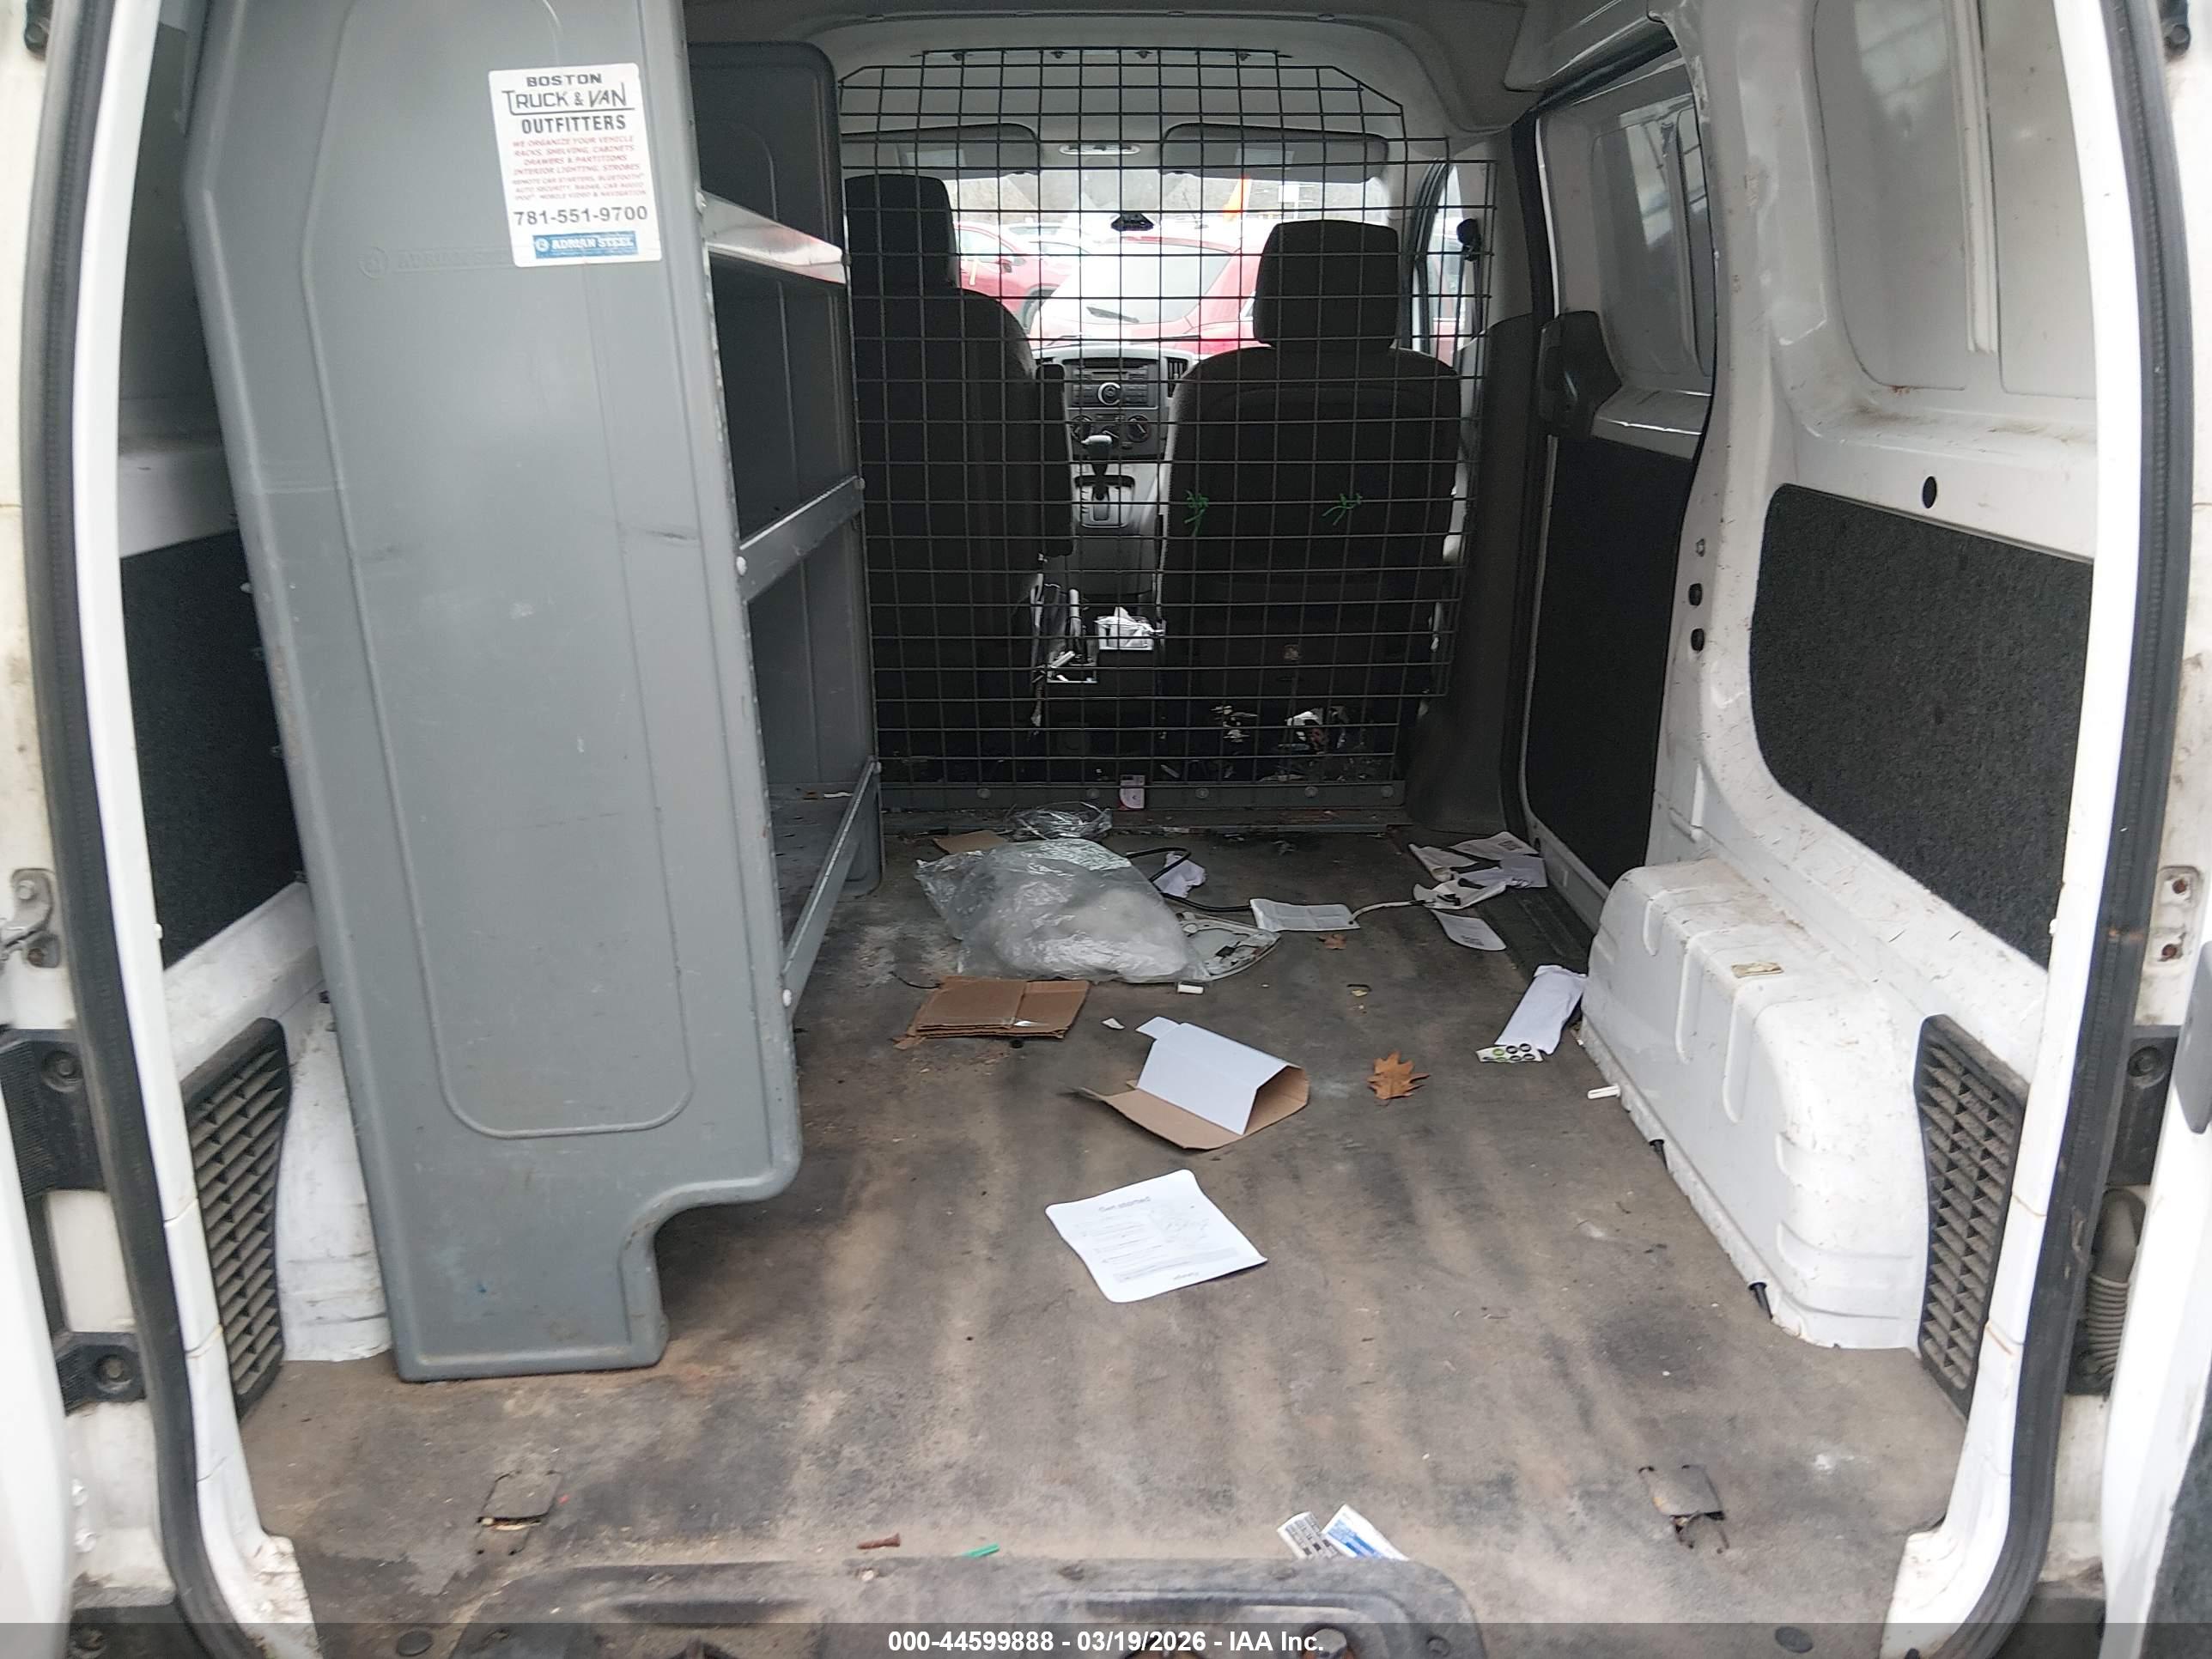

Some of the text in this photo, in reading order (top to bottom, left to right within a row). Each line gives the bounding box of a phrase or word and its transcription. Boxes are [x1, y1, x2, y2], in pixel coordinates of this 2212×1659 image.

[526, 74, 602, 87] BOSTON
[502, 83, 628, 115] TRUCK & VAN
[522, 115, 626, 133] OUTFITTERS
[514, 206, 647, 225] 781-551-9700
[552, 237, 634, 249] ADRIAN STEEL
